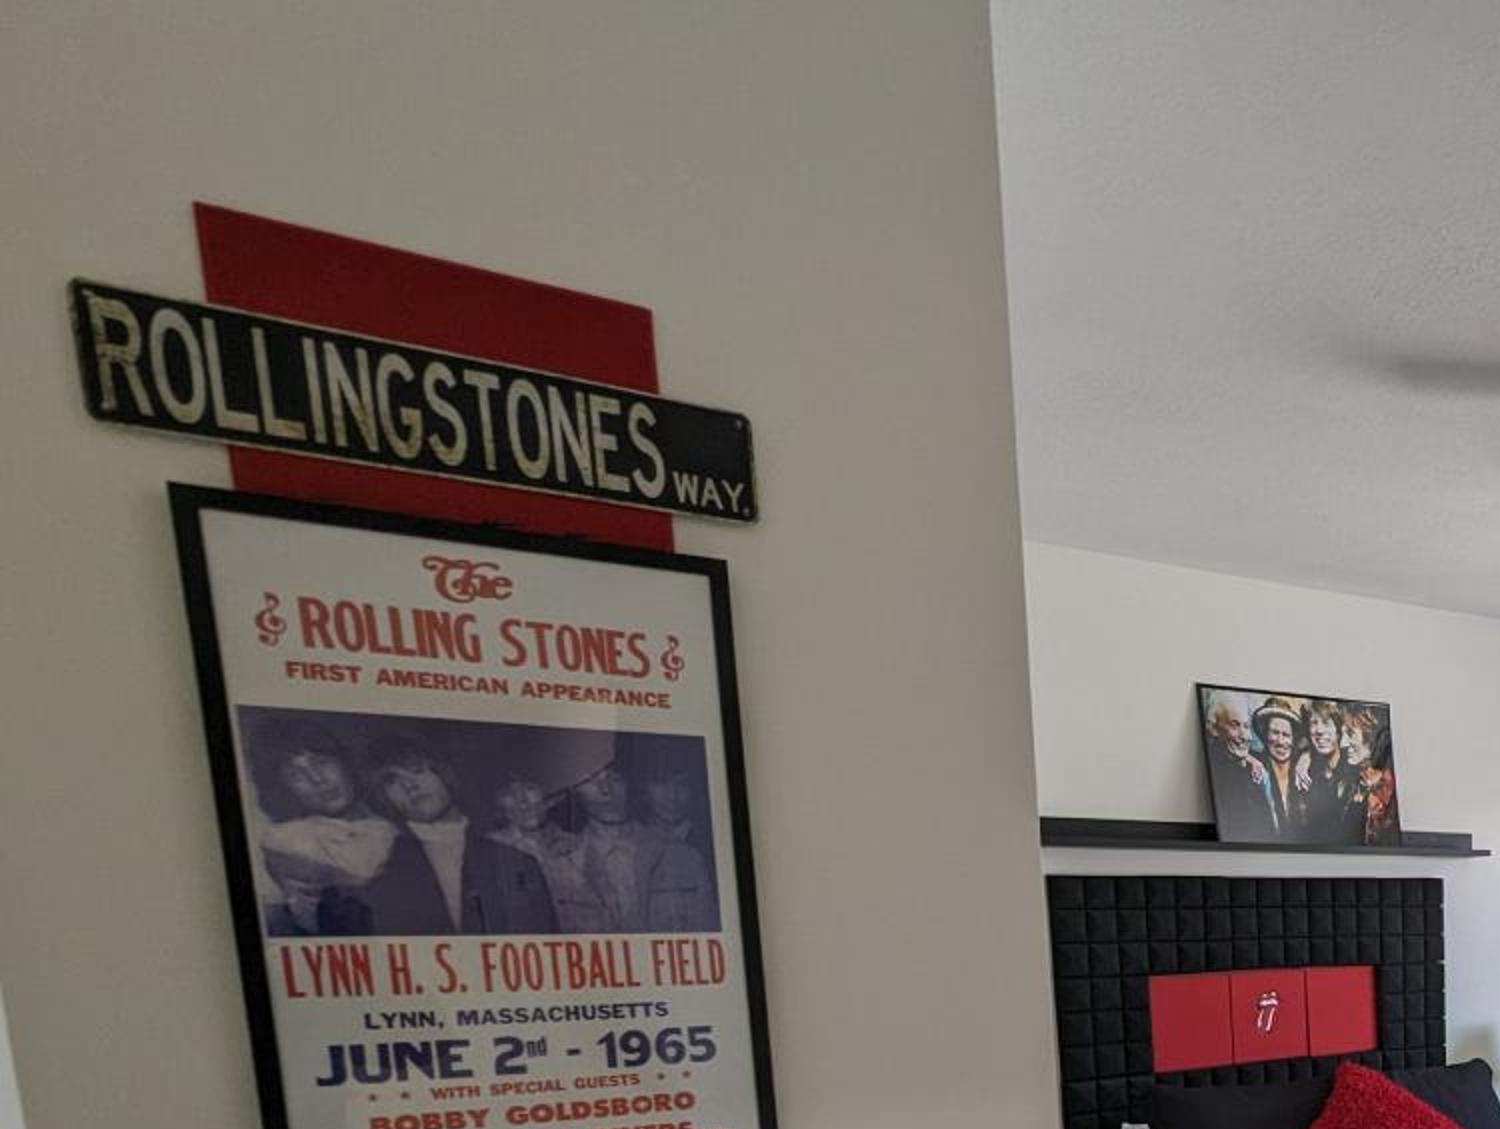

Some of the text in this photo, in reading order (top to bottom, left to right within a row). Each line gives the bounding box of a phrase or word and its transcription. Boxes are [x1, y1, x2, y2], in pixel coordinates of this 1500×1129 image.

[88, 293, 746, 512] ROLLINGSTONES WAY
[421, 554, 514, 604] The
[297, 597, 651, 679] ROLLING STONES
[285, 660, 672, 710] FIRST AMERICAN APPEARANCE
[281, 938, 726, 999] LYNN H. S. FOOTBALL FIELD
[363, 1001, 670, 1032] LYNN, MASSACHUSETTS
[315, 1038, 474, 1088] JUNE
[493, 1035, 548, 1077] 2nd
[596, 1025, 718, 1070] 1965
[431, 1072, 642, 1101] WITH SPECIAL GUESTS
[506, 1091, 697, 1127] GOLDSBORO
